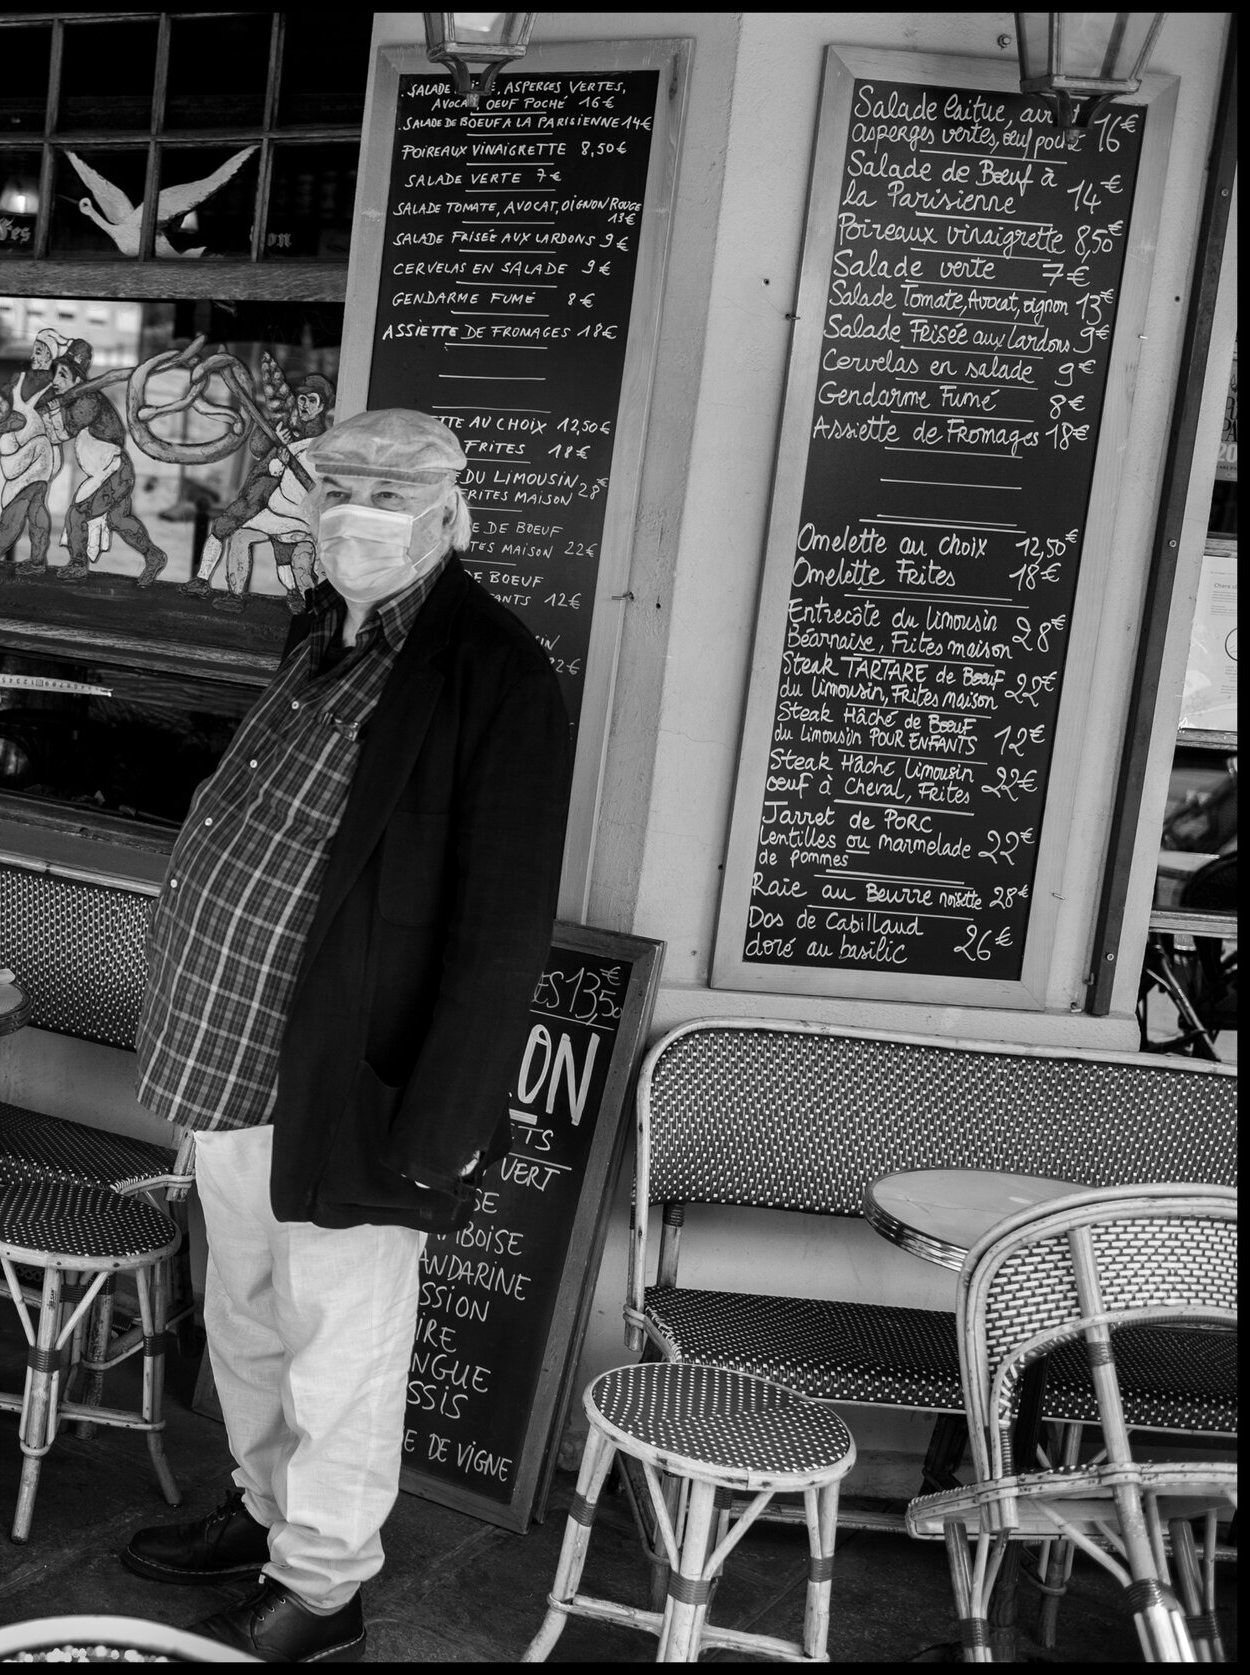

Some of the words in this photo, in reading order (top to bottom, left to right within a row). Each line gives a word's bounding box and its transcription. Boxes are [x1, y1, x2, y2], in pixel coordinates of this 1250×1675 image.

[504, 81, 562, 95] ASPERGES
[569, 81, 626, 94] VERTES,
[486, 99, 516, 110] OEUF
[524, 96, 568, 109] POCHÉ
[579, 96, 614, 109] 16€
[854, 85, 937, 121] Salade
[445, 118, 457, 128] DE
[459, 116, 501, 128] BOEUF
[502, 119, 512, 129] A
[515, 116, 532, 128] LA
[538, 114, 620, 129] PARISIENNE
[621, 116, 652, 130] 14€
[402, 145, 467, 159] POIREAUX
[472, 143, 566, 156] VINAIGRETTE
[581, 142, 627, 158] 8,50€
[852, 122, 934, 153] asperges
[405, 174, 462, 187] SALADE
[471, 172, 522, 184] VERTE
[537, 169, 562, 183] 7€
[848, 150, 932, 181] Salade
[942, 161, 970, 182] de
[1041, 168, 1057, 187] à
[393, 202, 441, 215] SALADE
[446, 201, 500, 217] TOMATE,
[504, 201, 558, 215] AVOCAT,
[610, 197, 642, 211] ROUGE
[842, 180, 876, 207] la
[888, 181, 1016, 214] Parisienne
[608, 213, 636, 225] 13€
[393, 232, 444, 245] SALADE
[452, 229, 497, 244] FRISÉE
[502, 233, 530, 245] AUX
[535, 232, 595, 246] LARDONS
[599, 234, 628, 251] 9€
[839, 213, 937, 245] Poireaux
[947, 224, 1065, 258] vinaigrette
[393, 262, 467, 275] CERVELAS
[472, 263, 493, 274] EN
[501, 262, 568, 275] SALADE
[833, 249, 923, 278] Salade
[941, 258, 996, 279] verte
[1042, 263, 1090, 287] 7€
[392, 292, 479, 306] GENDARME
[490, 292, 535, 304] FUMÉ
[829, 279, 896, 309] Salade
[382, 320, 459, 340] ASSIETTE
[461, 326, 486, 339] DE
[491, 325, 571, 338] FROMAGES
[577, 324, 617, 340] 18€
[823, 314, 900, 342] Salade
[973, 330, 1006, 351] aux
[823, 349, 919, 373] Cervelas
[930, 360, 956, 376] en
[966, 356, 1034, 383] salade
[1055, 360, 1095, 386] 9€
[819, 382, 930, 408] Gendarme
[940, 386, 999, 411] Fumé
[1050, 395, 1085, 418] 8€
[469, 416, 491, 429] AU
[497, 418, 547, 435] CHOIX
[557, 418, 611, 435] 12,50€
[812, 416, 899, 440] Assiette
[913, 421, 943, 444] de
[1046, 422, 1090, 449] 18€
[464, 440, 525, 454] FRITES
[549, 444, 591, 459] 18€
[460, 470, 486, 484] DU
[494, 470, 579, 488] LIMOUSIN
[515, 492, 572, 506] MAISON
[484, 522, 510, 534] DE
[516, 522, 563, 537] BOEUF
[797, 523, 887, 553] Omelette
[900, 539, 927, 555] au
[502, 542, 553, 558] MAISON
[565, 542, 597, 557] 22€
[490, 571, 544, 587] BOEUF
[791, 556, 885, 587] Omelette
[1009, 563, 1061, 590] 18€
[544, 593, 582, 609] 12€
[788, 596, 880, 627] Entrecôte
[892, 608, 918, 629] du
[948, 644, 1013, 659] maison
[783, 651, 839, 675] Steak
[841, 656, 929, 682] TARTARE
[936, 667, 956, 685] de
[780, 678, 803, 697] du
[941, 694, 998, 710] maison
[777, 701, 833, 722] Steak
[904, 714, 921, 729] de
[774, 727, 797, 741] du
[870, 731, 904, 747] POUR
[909, 732, 977, 755] ENFANTS
[771, 748, 833, 772] Steak
[982, 767, 1038, 801] 22€
[819, 775, 832, 795] à
[762, 801, 835, 826] Jarret
[850, 810, 875, 830] de
[759, 848, 777, 865] de
[847, 835, 870, 848] ou
[879, 834, 971, 859] marmelade
[752, 872, 807, 898] Raie
[822, 886, 856, 901] au
[866, 883, 933, 905] Beurre
[749, 906, 784, 928] Dos
[797, 909, 816, 929] de
[826, 911, 923, 937] Cabillaud
[745, 932, 796, 956] doré
[807, 943, 832, 957] au
[839, 935, 907, 963] basilic
[500, 1158, 561, 1191] VERT
[419, 1247, 531, 1301] ANDARINE
[428, 1433, 451, 1462] DE
[459, 1441, 513, 1481] VIGNE
